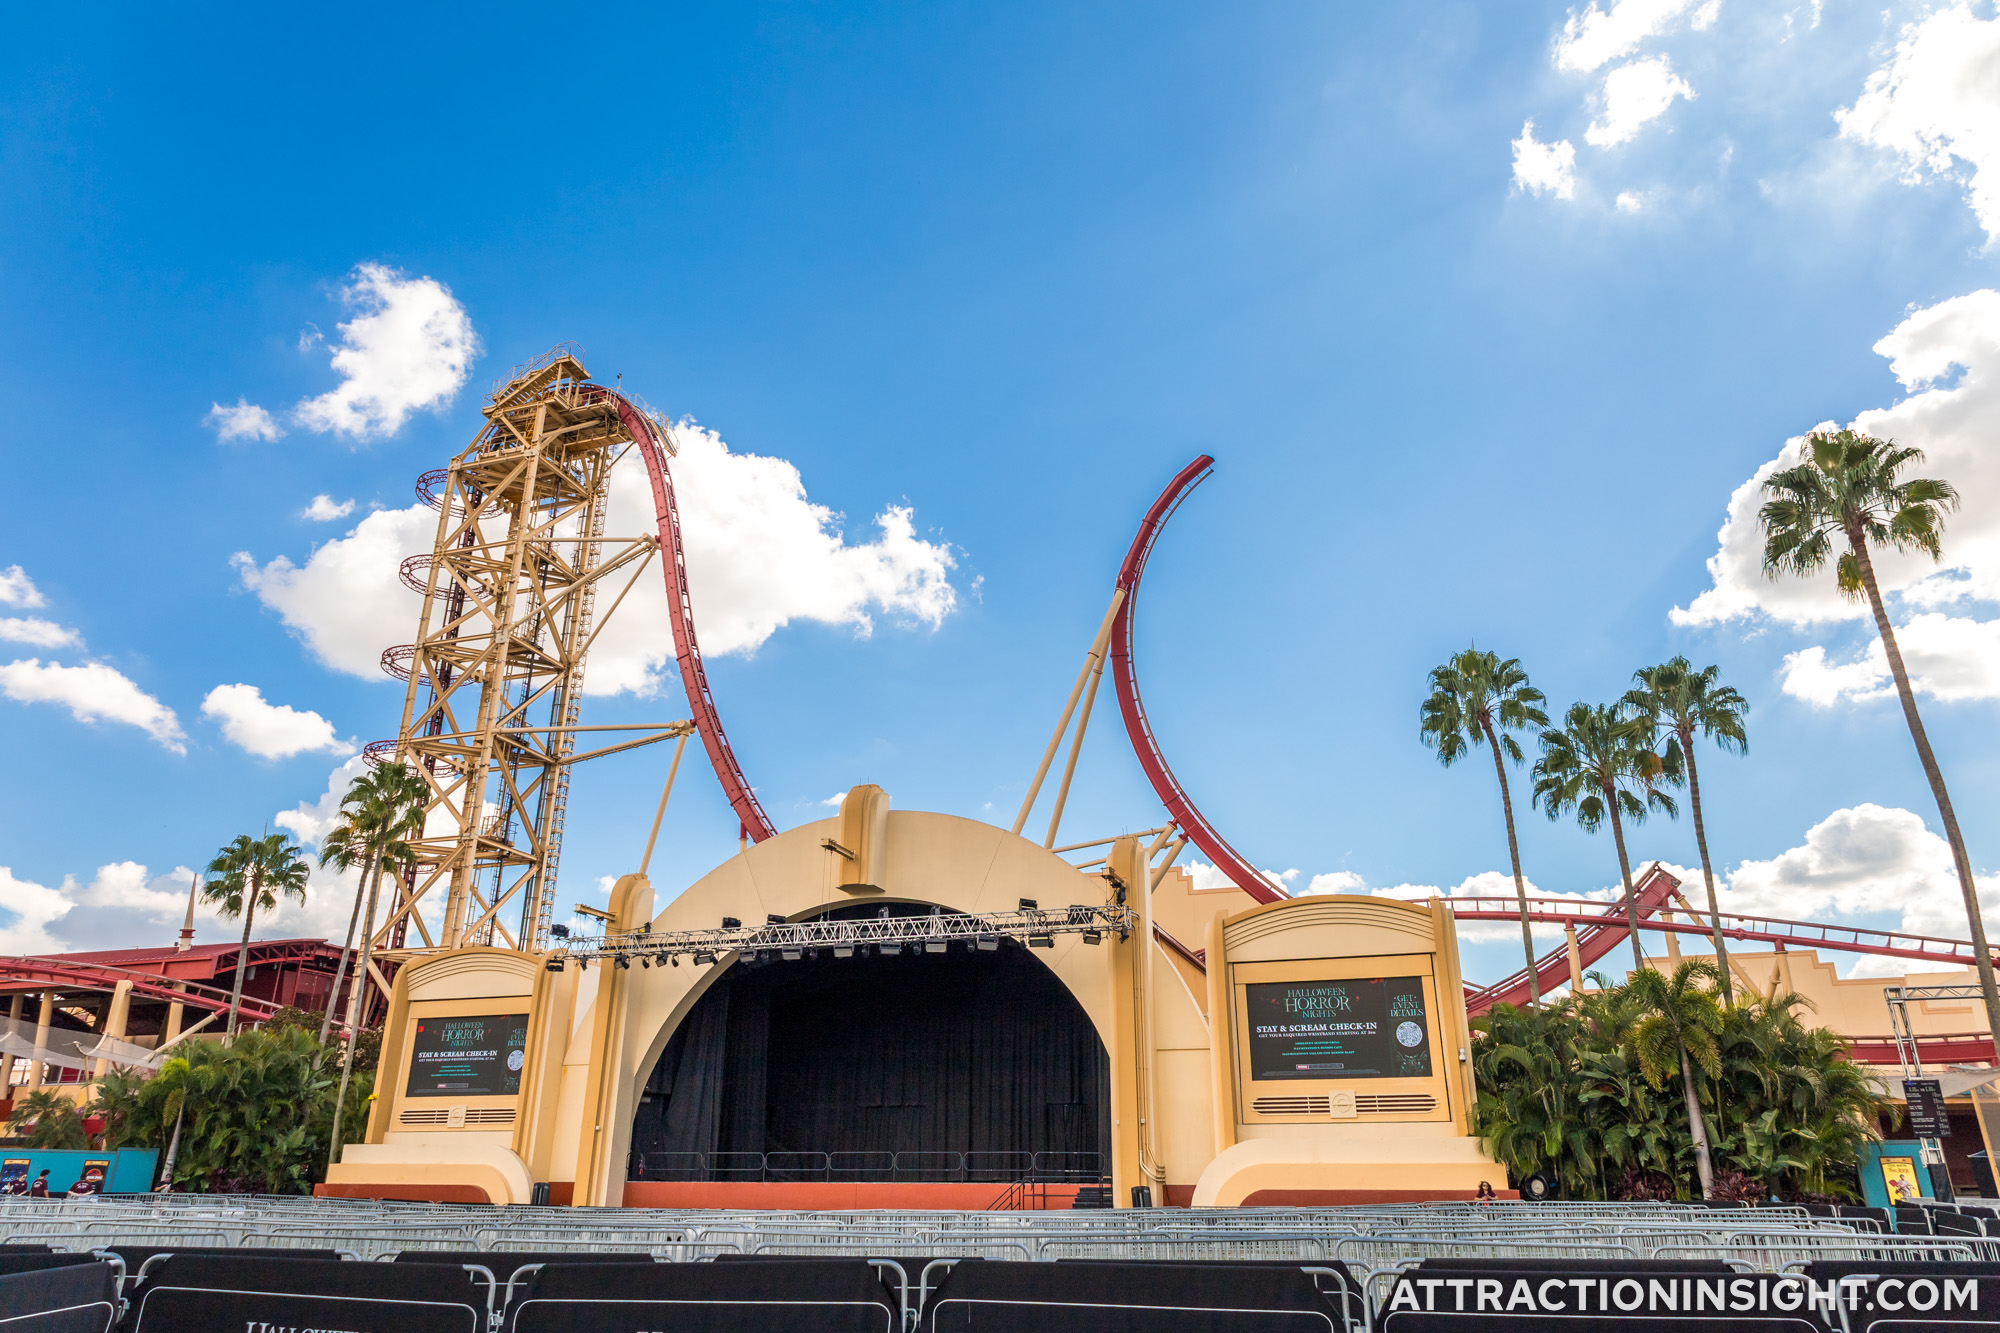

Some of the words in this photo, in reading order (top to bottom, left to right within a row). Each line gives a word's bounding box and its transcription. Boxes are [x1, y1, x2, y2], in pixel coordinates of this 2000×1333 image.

[1287, 987, 1346, 998] HALLOWEEN
[1396, 994, 1413, 1002] GET
[1284, 996, 1352, 1013] HORROR
[1392, 1001, 1420, 1009] EVENT
[1302, 1009, 1337, 1018] NIGHTS
[1390, 1008, 1424, 1017] DETAILS
[1256, 1025, 1278, 1033] STAY
[1289, 1023, 1327, 1032] SCREAM
[1329, 1022, 1377, 1031] CHECK-IN
[441, 1029, 485, 1042] HORROR
[466, 1049, 498, 1057] CHECK-IN
